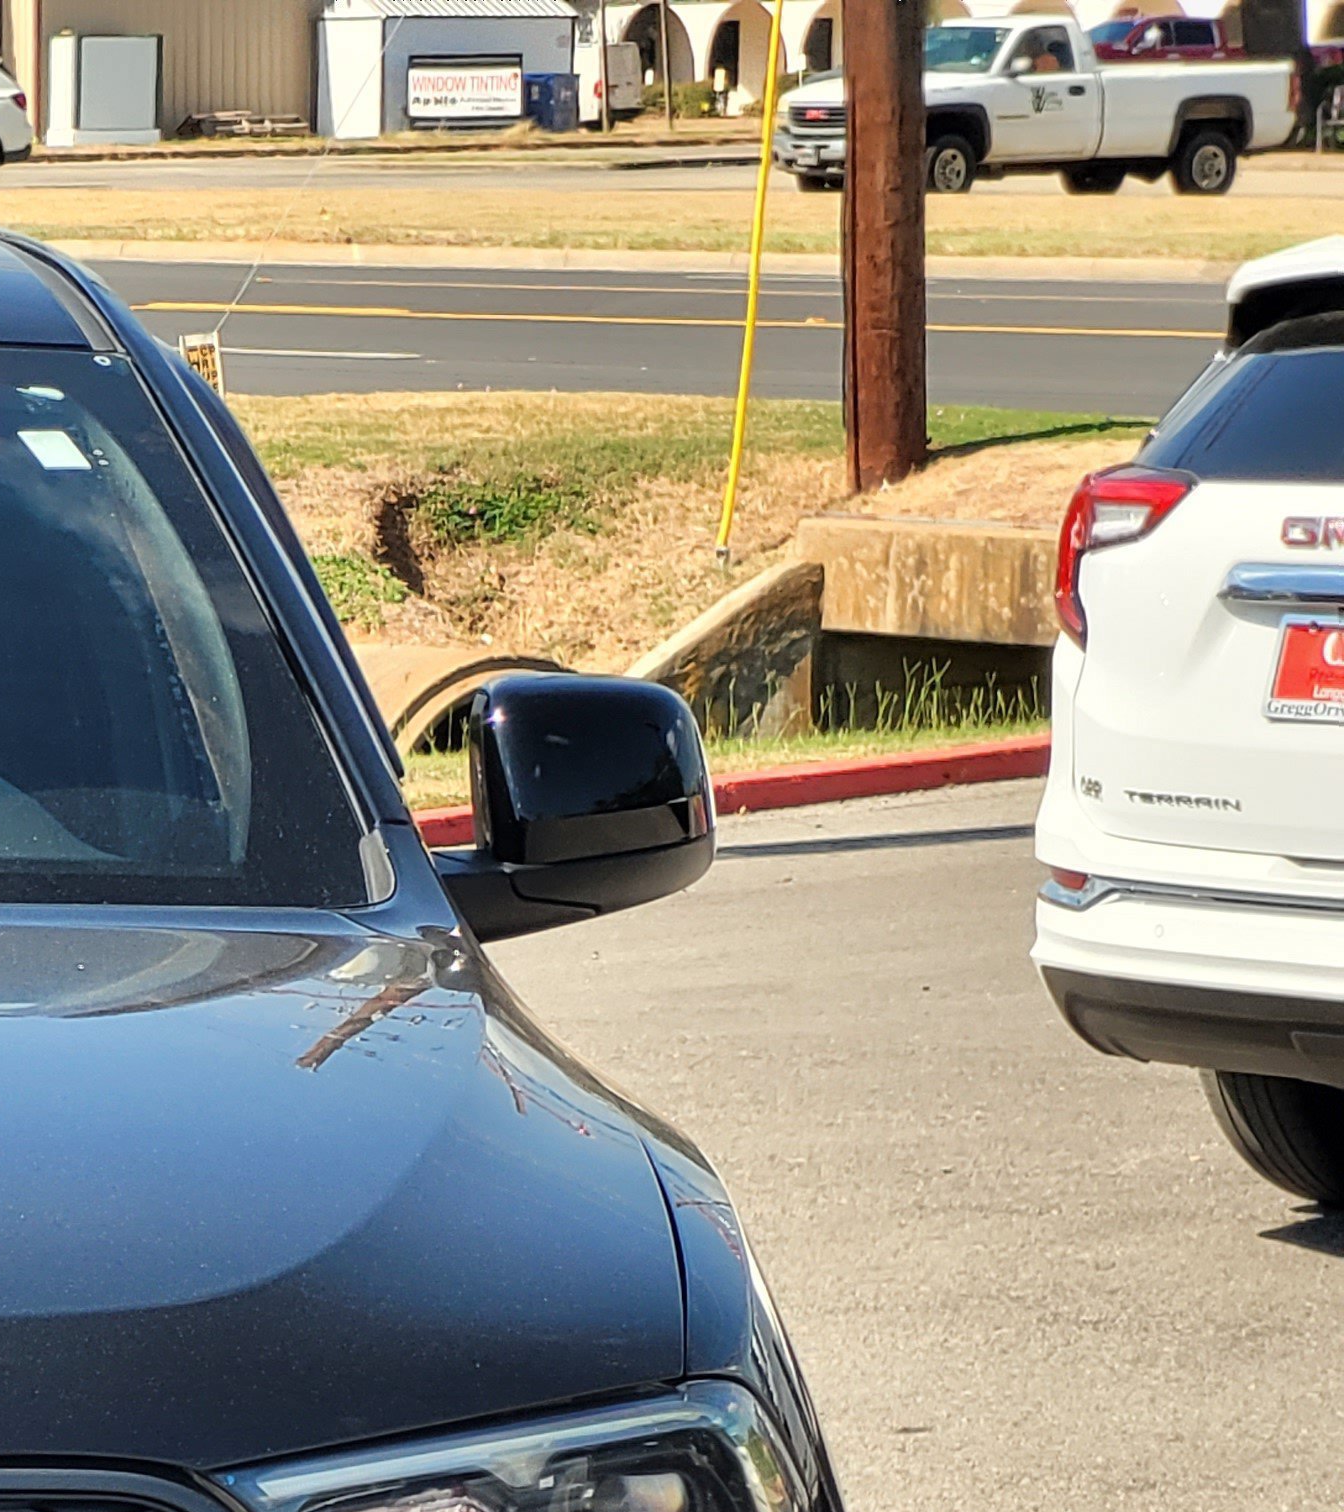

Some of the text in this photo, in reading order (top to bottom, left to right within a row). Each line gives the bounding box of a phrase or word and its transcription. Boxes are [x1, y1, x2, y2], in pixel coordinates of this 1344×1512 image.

[412, 73, 517, 92] WINDOW TINTING
[1124, 789, 1242, 812] TERRAIN
